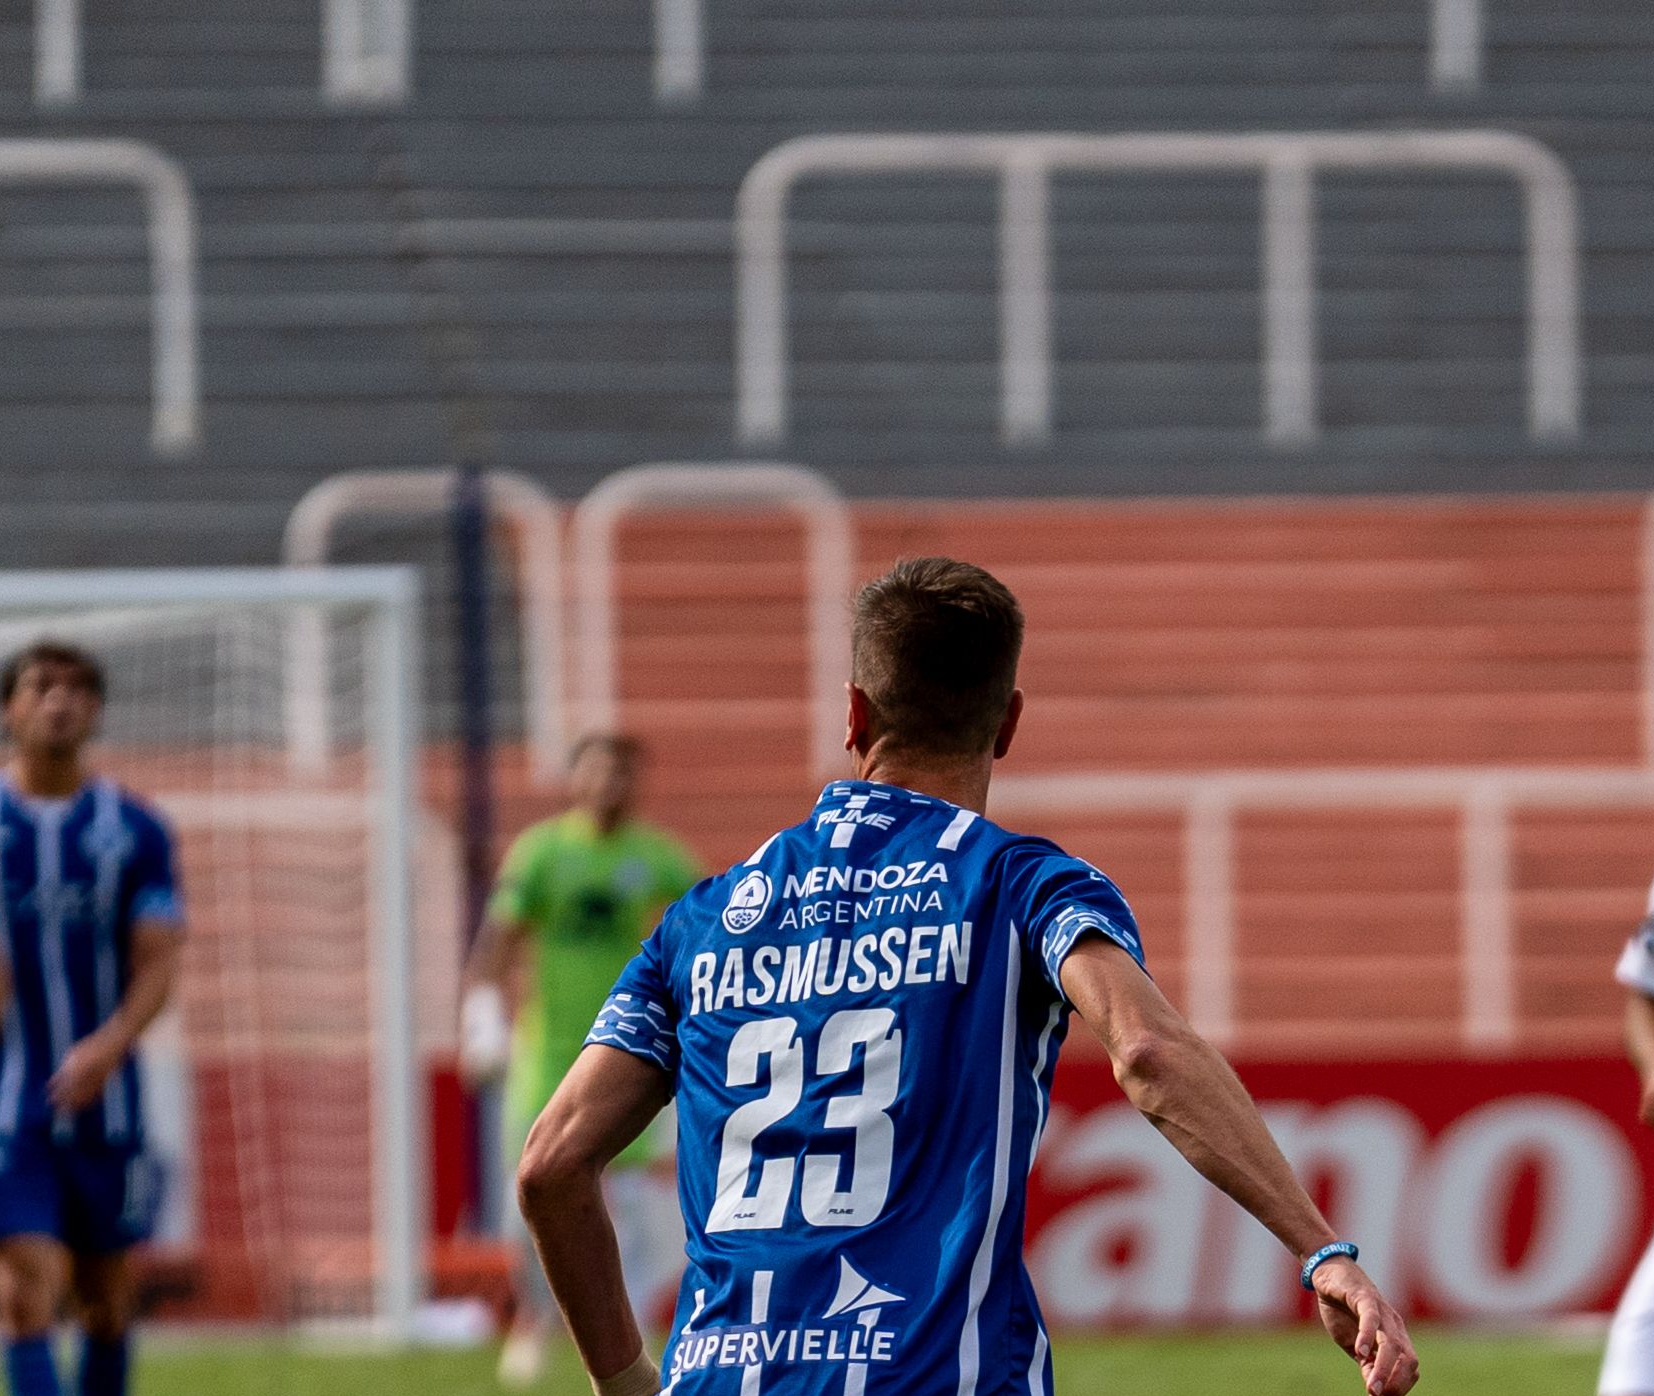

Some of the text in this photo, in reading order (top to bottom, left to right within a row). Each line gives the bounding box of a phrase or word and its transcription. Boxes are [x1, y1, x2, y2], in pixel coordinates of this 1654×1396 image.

[815, 808, 896, 832] FIUME
[782, 860, 949, 899] MENDOZA
[778, 890, 944, 932] ARGENTINA
[689, 921, 973, 1016] RASMUSSEN
[704, 1006, 902, 1234] 23
[670, 1328, 896, 1375] SUPERVIELLE
